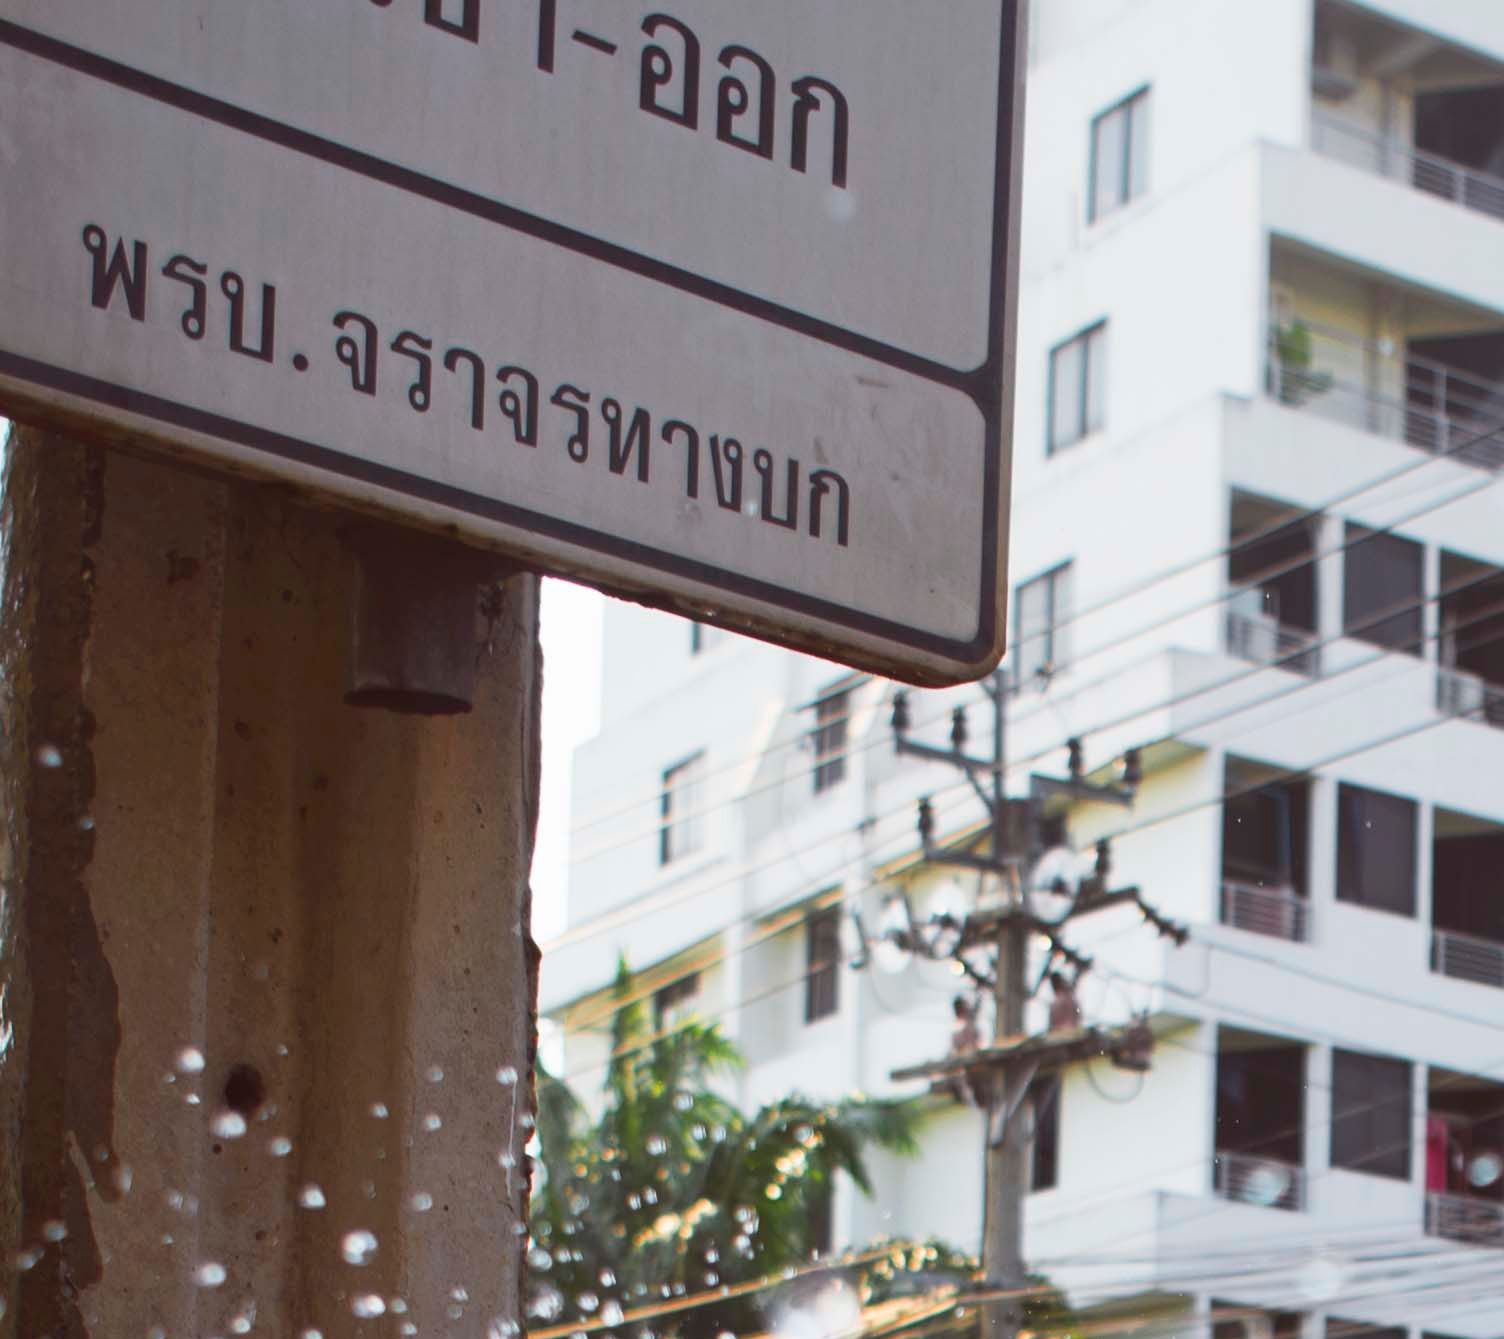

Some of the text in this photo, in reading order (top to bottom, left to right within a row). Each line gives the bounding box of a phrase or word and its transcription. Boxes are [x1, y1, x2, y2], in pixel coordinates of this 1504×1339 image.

[368, 0, 851, 189] า-ออก
[80, 221, 852, 548] พรบ.จราจรทางบก
